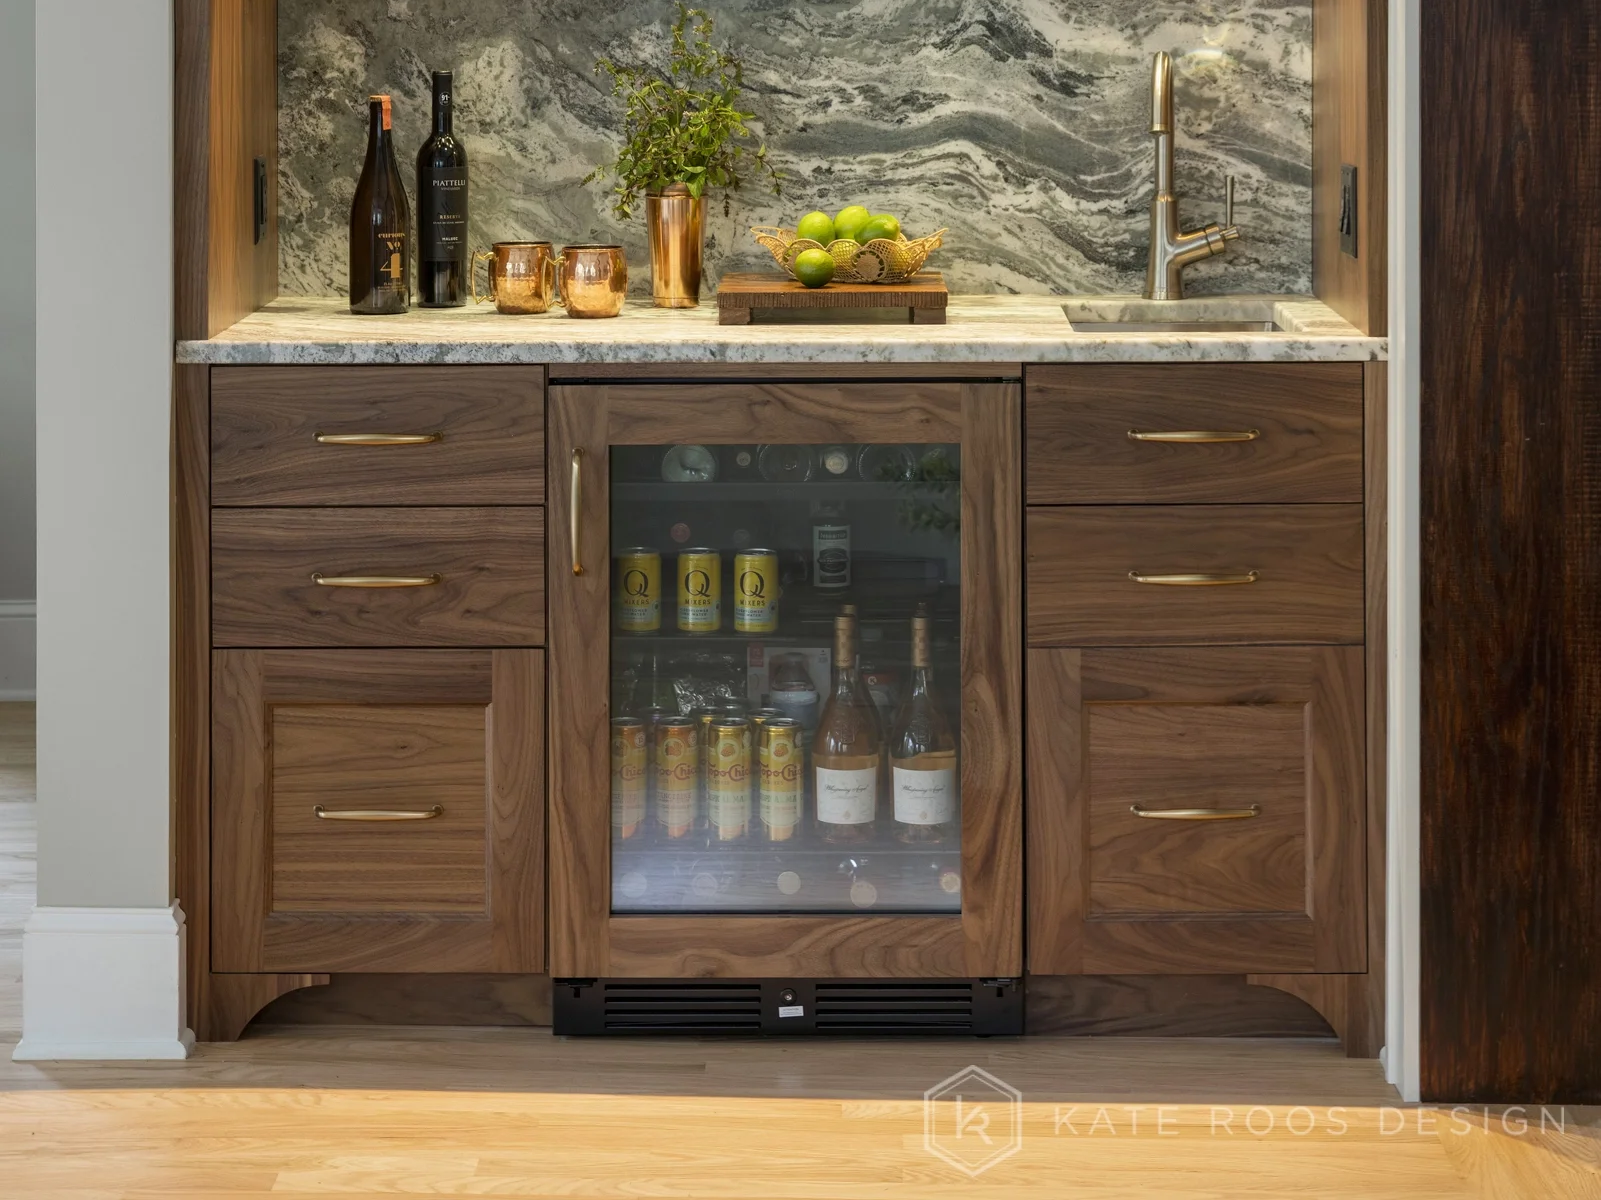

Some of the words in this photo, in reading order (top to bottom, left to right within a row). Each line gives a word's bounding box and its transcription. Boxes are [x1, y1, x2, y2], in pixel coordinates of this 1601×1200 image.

[432, 179, 466, 187] PIATTELLI
[380, 252, 404, 278] 4
[623, 569, 649, 597] Q
[684, 569, 711, 598] Q
[739, 570, 765, 599] Q
